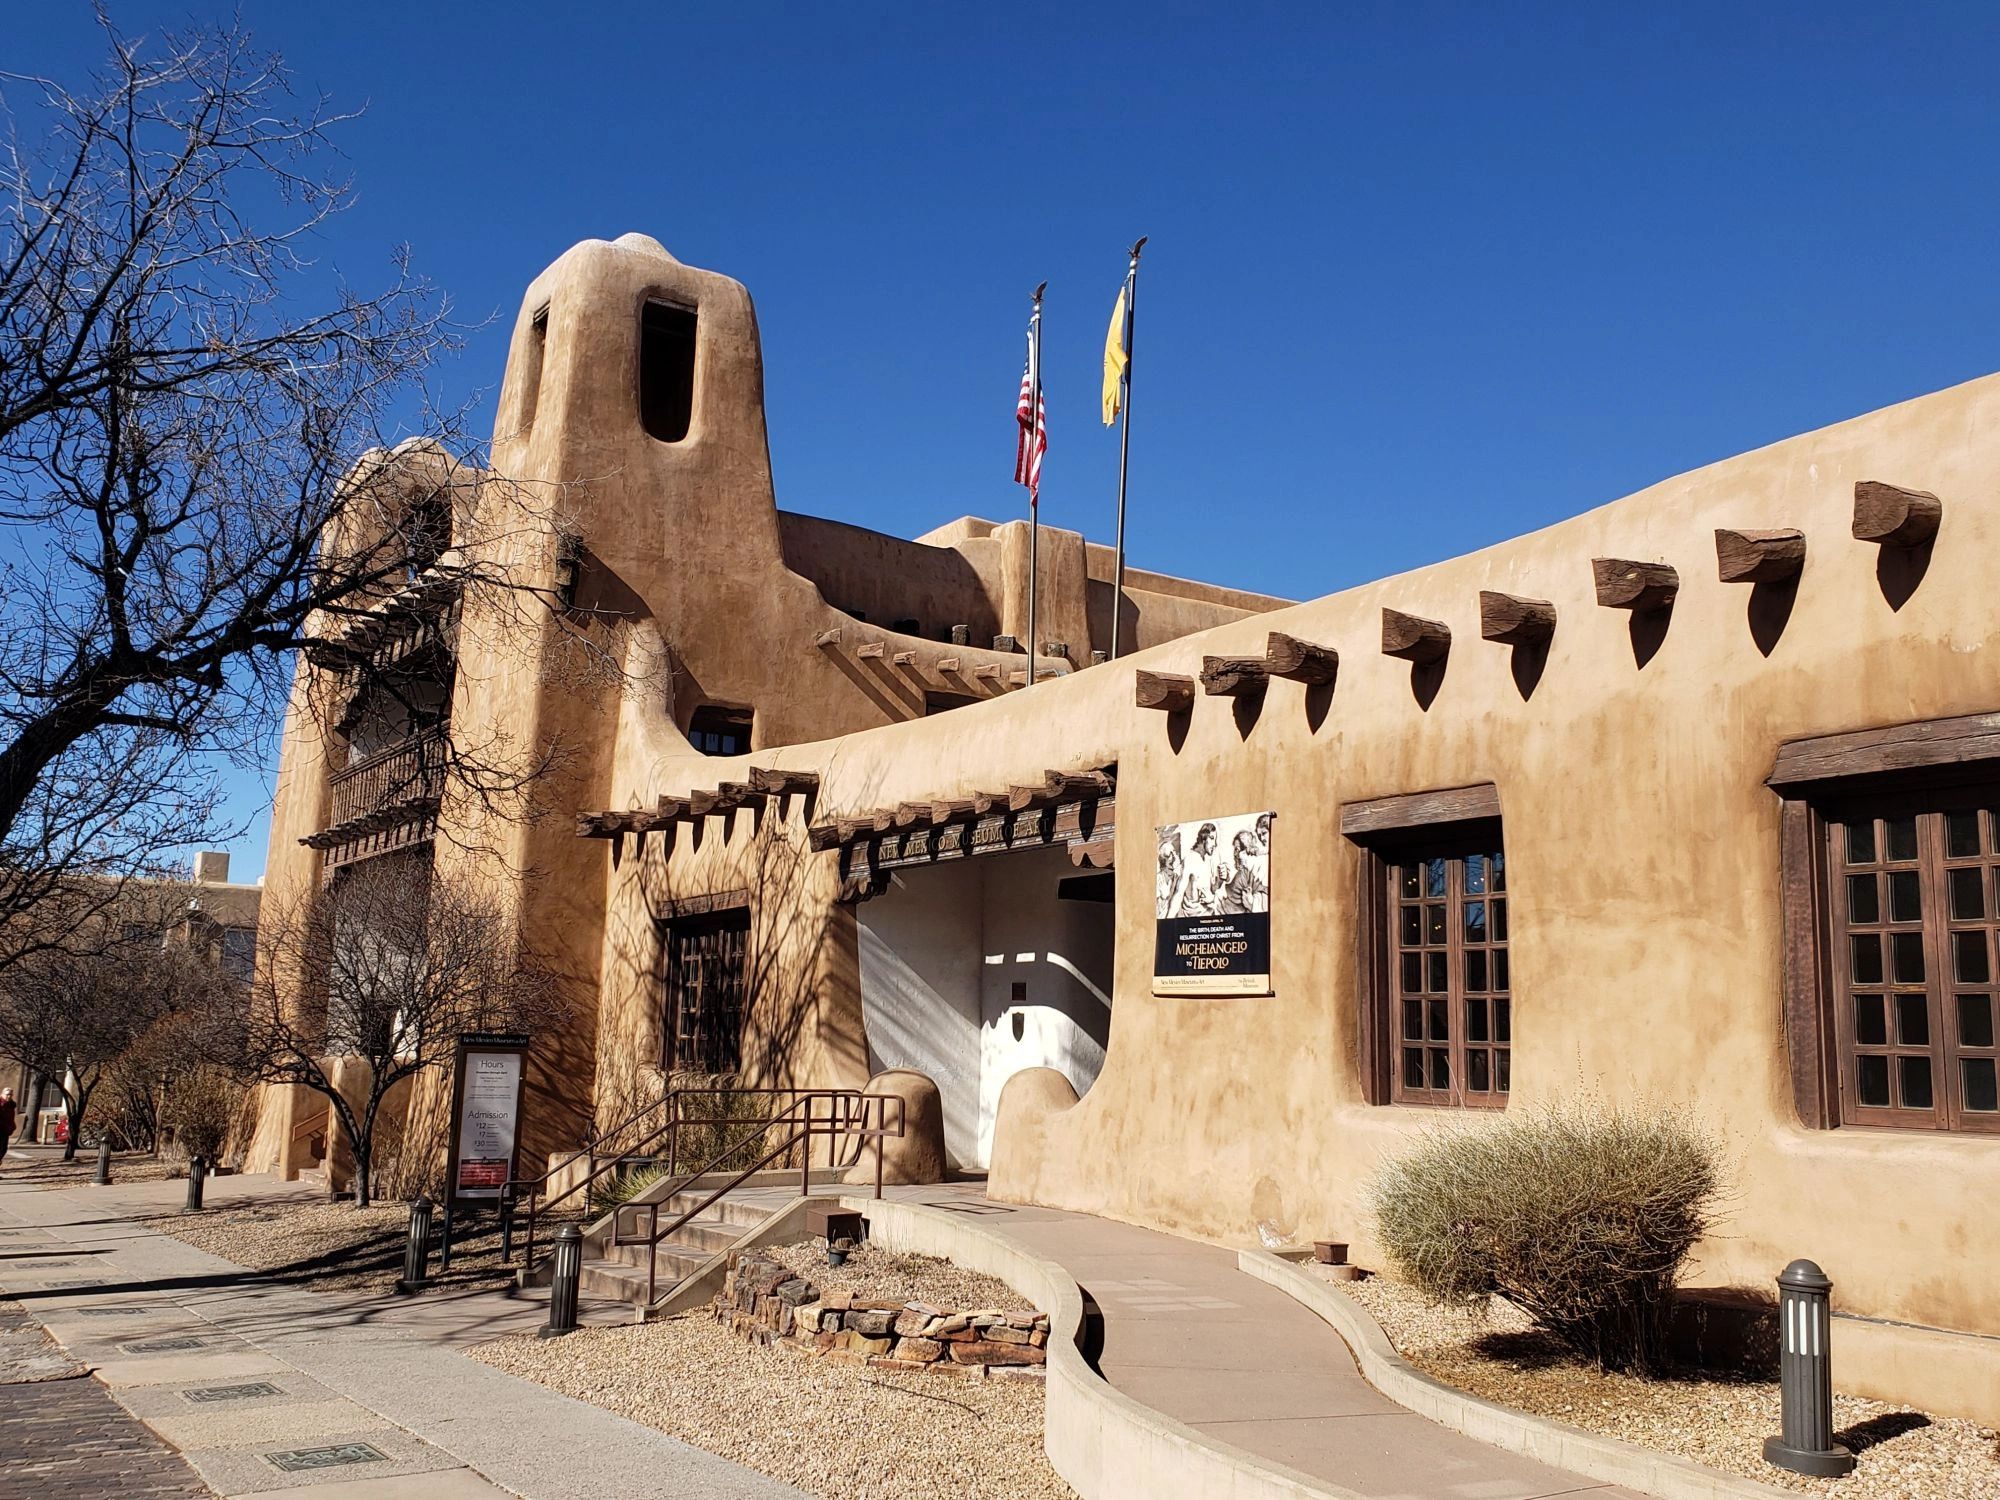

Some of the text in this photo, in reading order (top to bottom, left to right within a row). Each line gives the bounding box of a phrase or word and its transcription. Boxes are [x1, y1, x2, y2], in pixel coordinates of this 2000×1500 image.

[878, 817, 1050, 860] NEW MEXICO MUSEUM OF ART
[1179, 933, 1210, 941] RESURRECTION
[1175, 941, 1248, 956] MICHELANGELO
[1191, 955, 1229, 970] TIEPOLO
[481, 1059, 504, 1069] Hours
[468, 1110, 508, 1119] Admission
